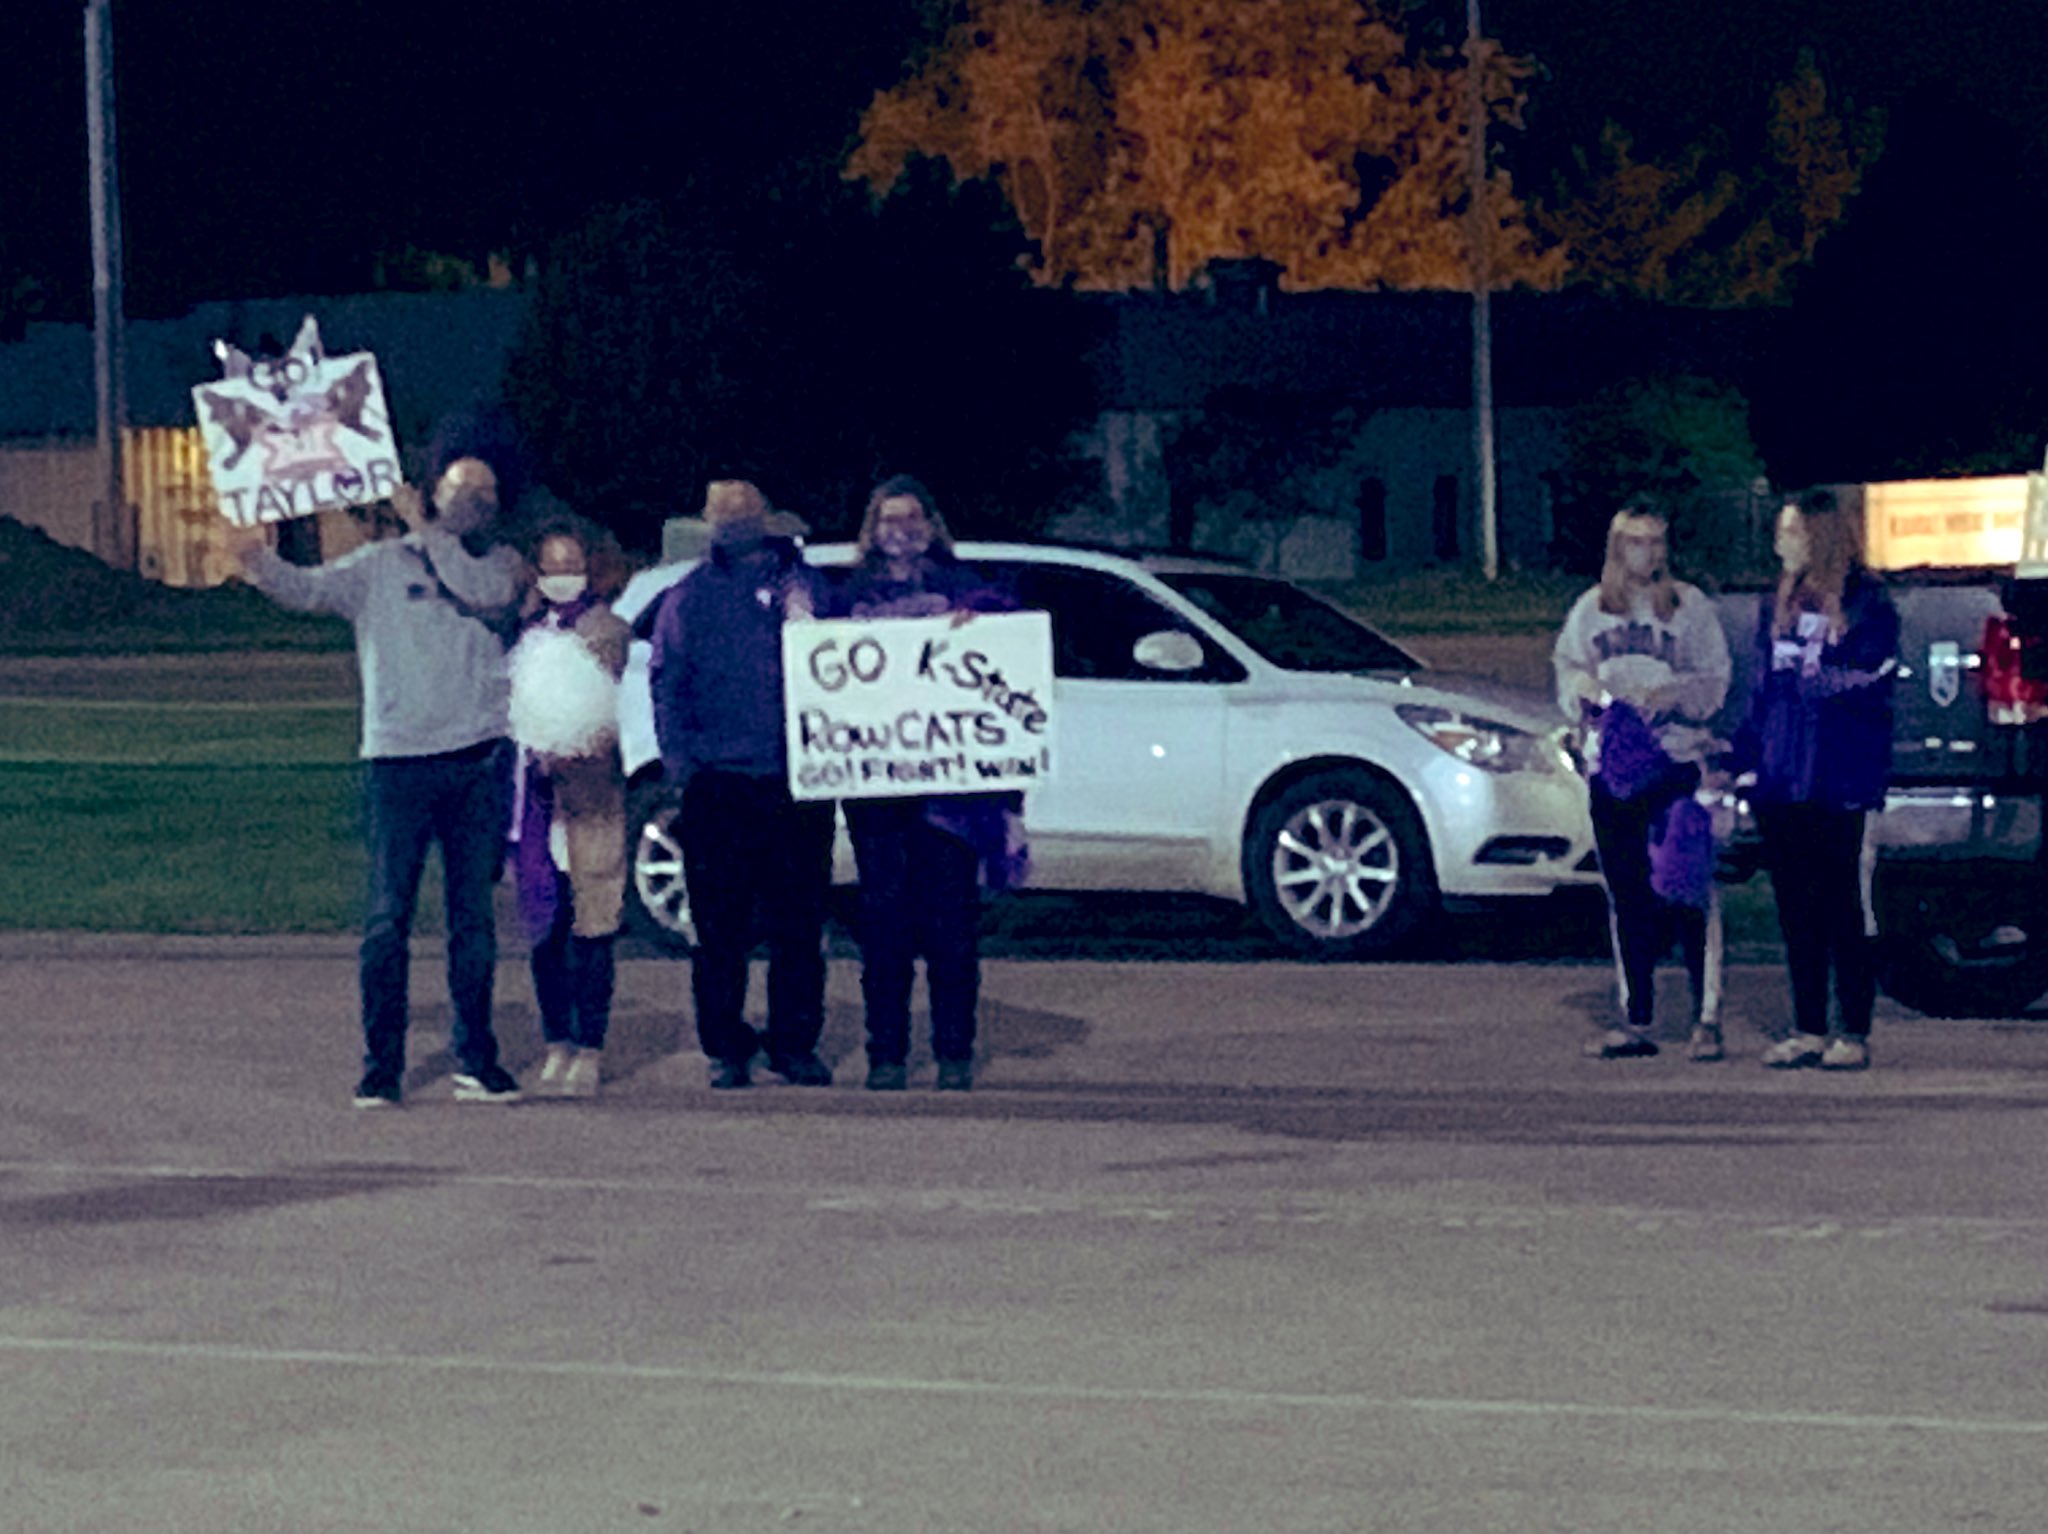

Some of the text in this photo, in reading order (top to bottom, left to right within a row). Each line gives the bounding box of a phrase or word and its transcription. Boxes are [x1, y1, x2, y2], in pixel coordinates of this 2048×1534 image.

[223, 457, 402, 525] TAYLOR
[808, 635, 887, 692] GO
[974, 745, 1050, 779] WIN!
